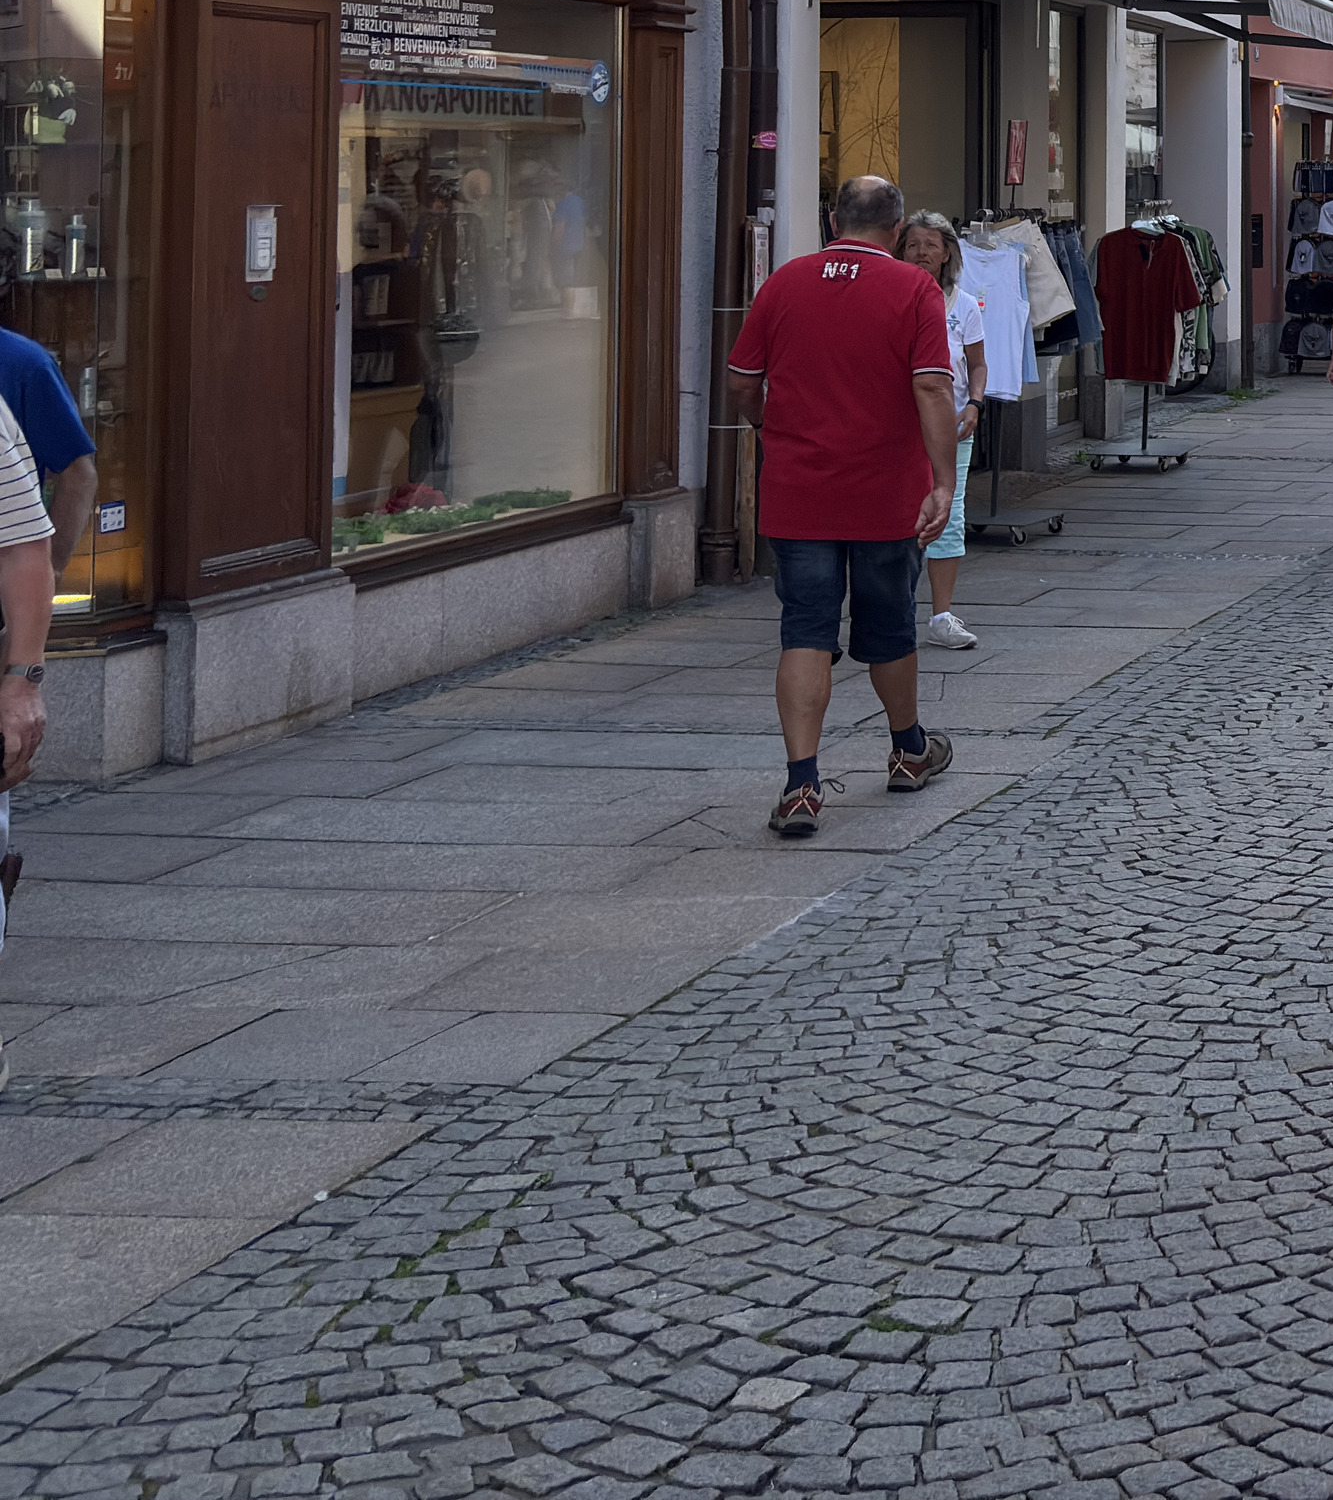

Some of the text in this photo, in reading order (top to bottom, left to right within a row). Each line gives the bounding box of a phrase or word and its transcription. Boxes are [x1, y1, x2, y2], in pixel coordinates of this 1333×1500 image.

[438, 11, 479, 26] BIENVENUE
[354, 18, 392, 33] HERZLICH
[394, 21, 448, 38] WILLKOMMEN
[394, 37, 446, 55] BENVENUTO
[433, 56, 464, 68] WELCOME
